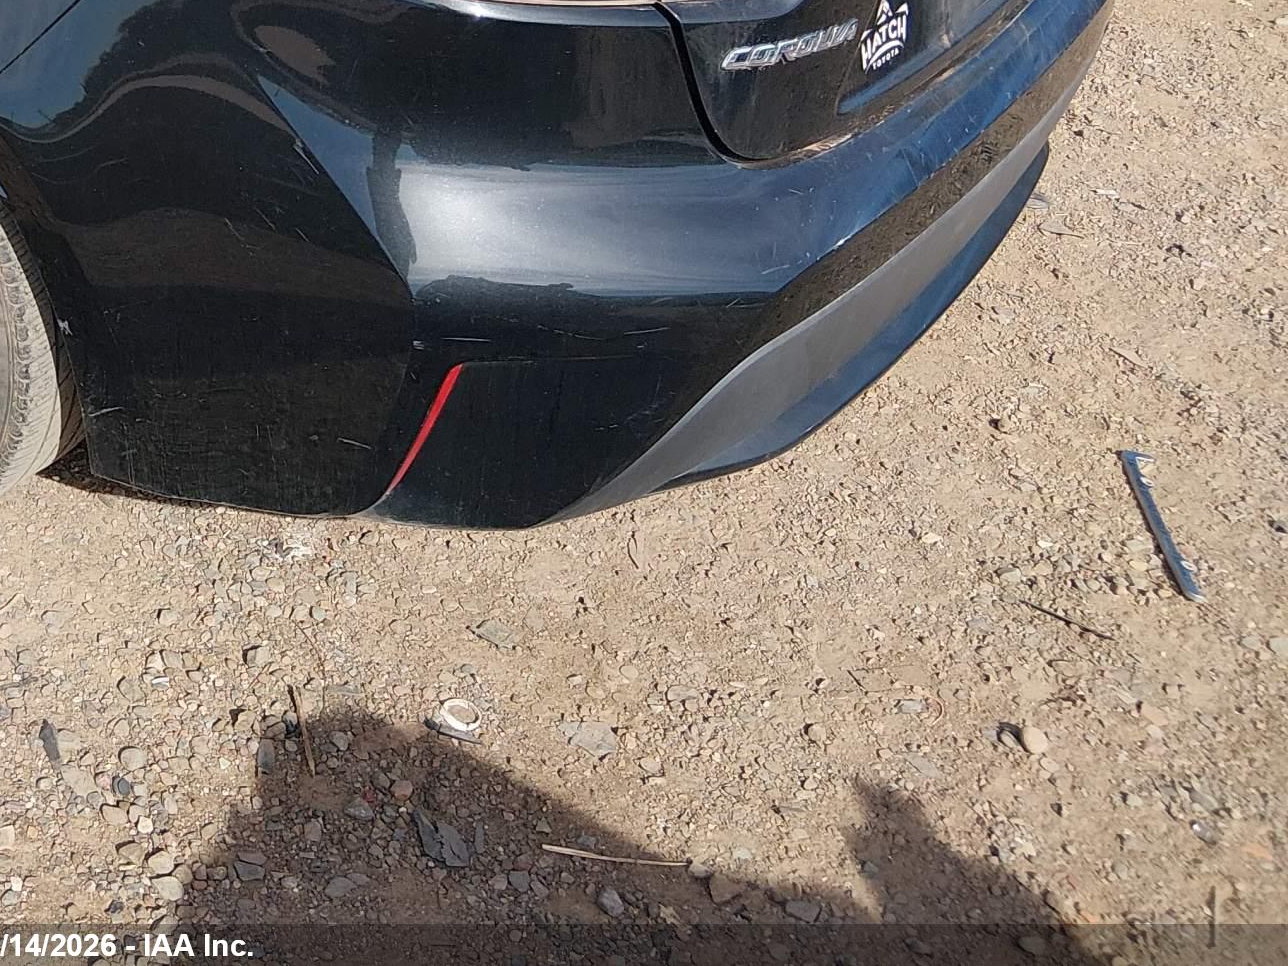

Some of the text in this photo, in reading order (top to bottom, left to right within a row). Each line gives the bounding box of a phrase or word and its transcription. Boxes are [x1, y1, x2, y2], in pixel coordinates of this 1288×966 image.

[720, 18, 859, 70] COROLLA
[861, 12, 908, 72] HATCH
[872, 47, 900, 70] TOYOTA
